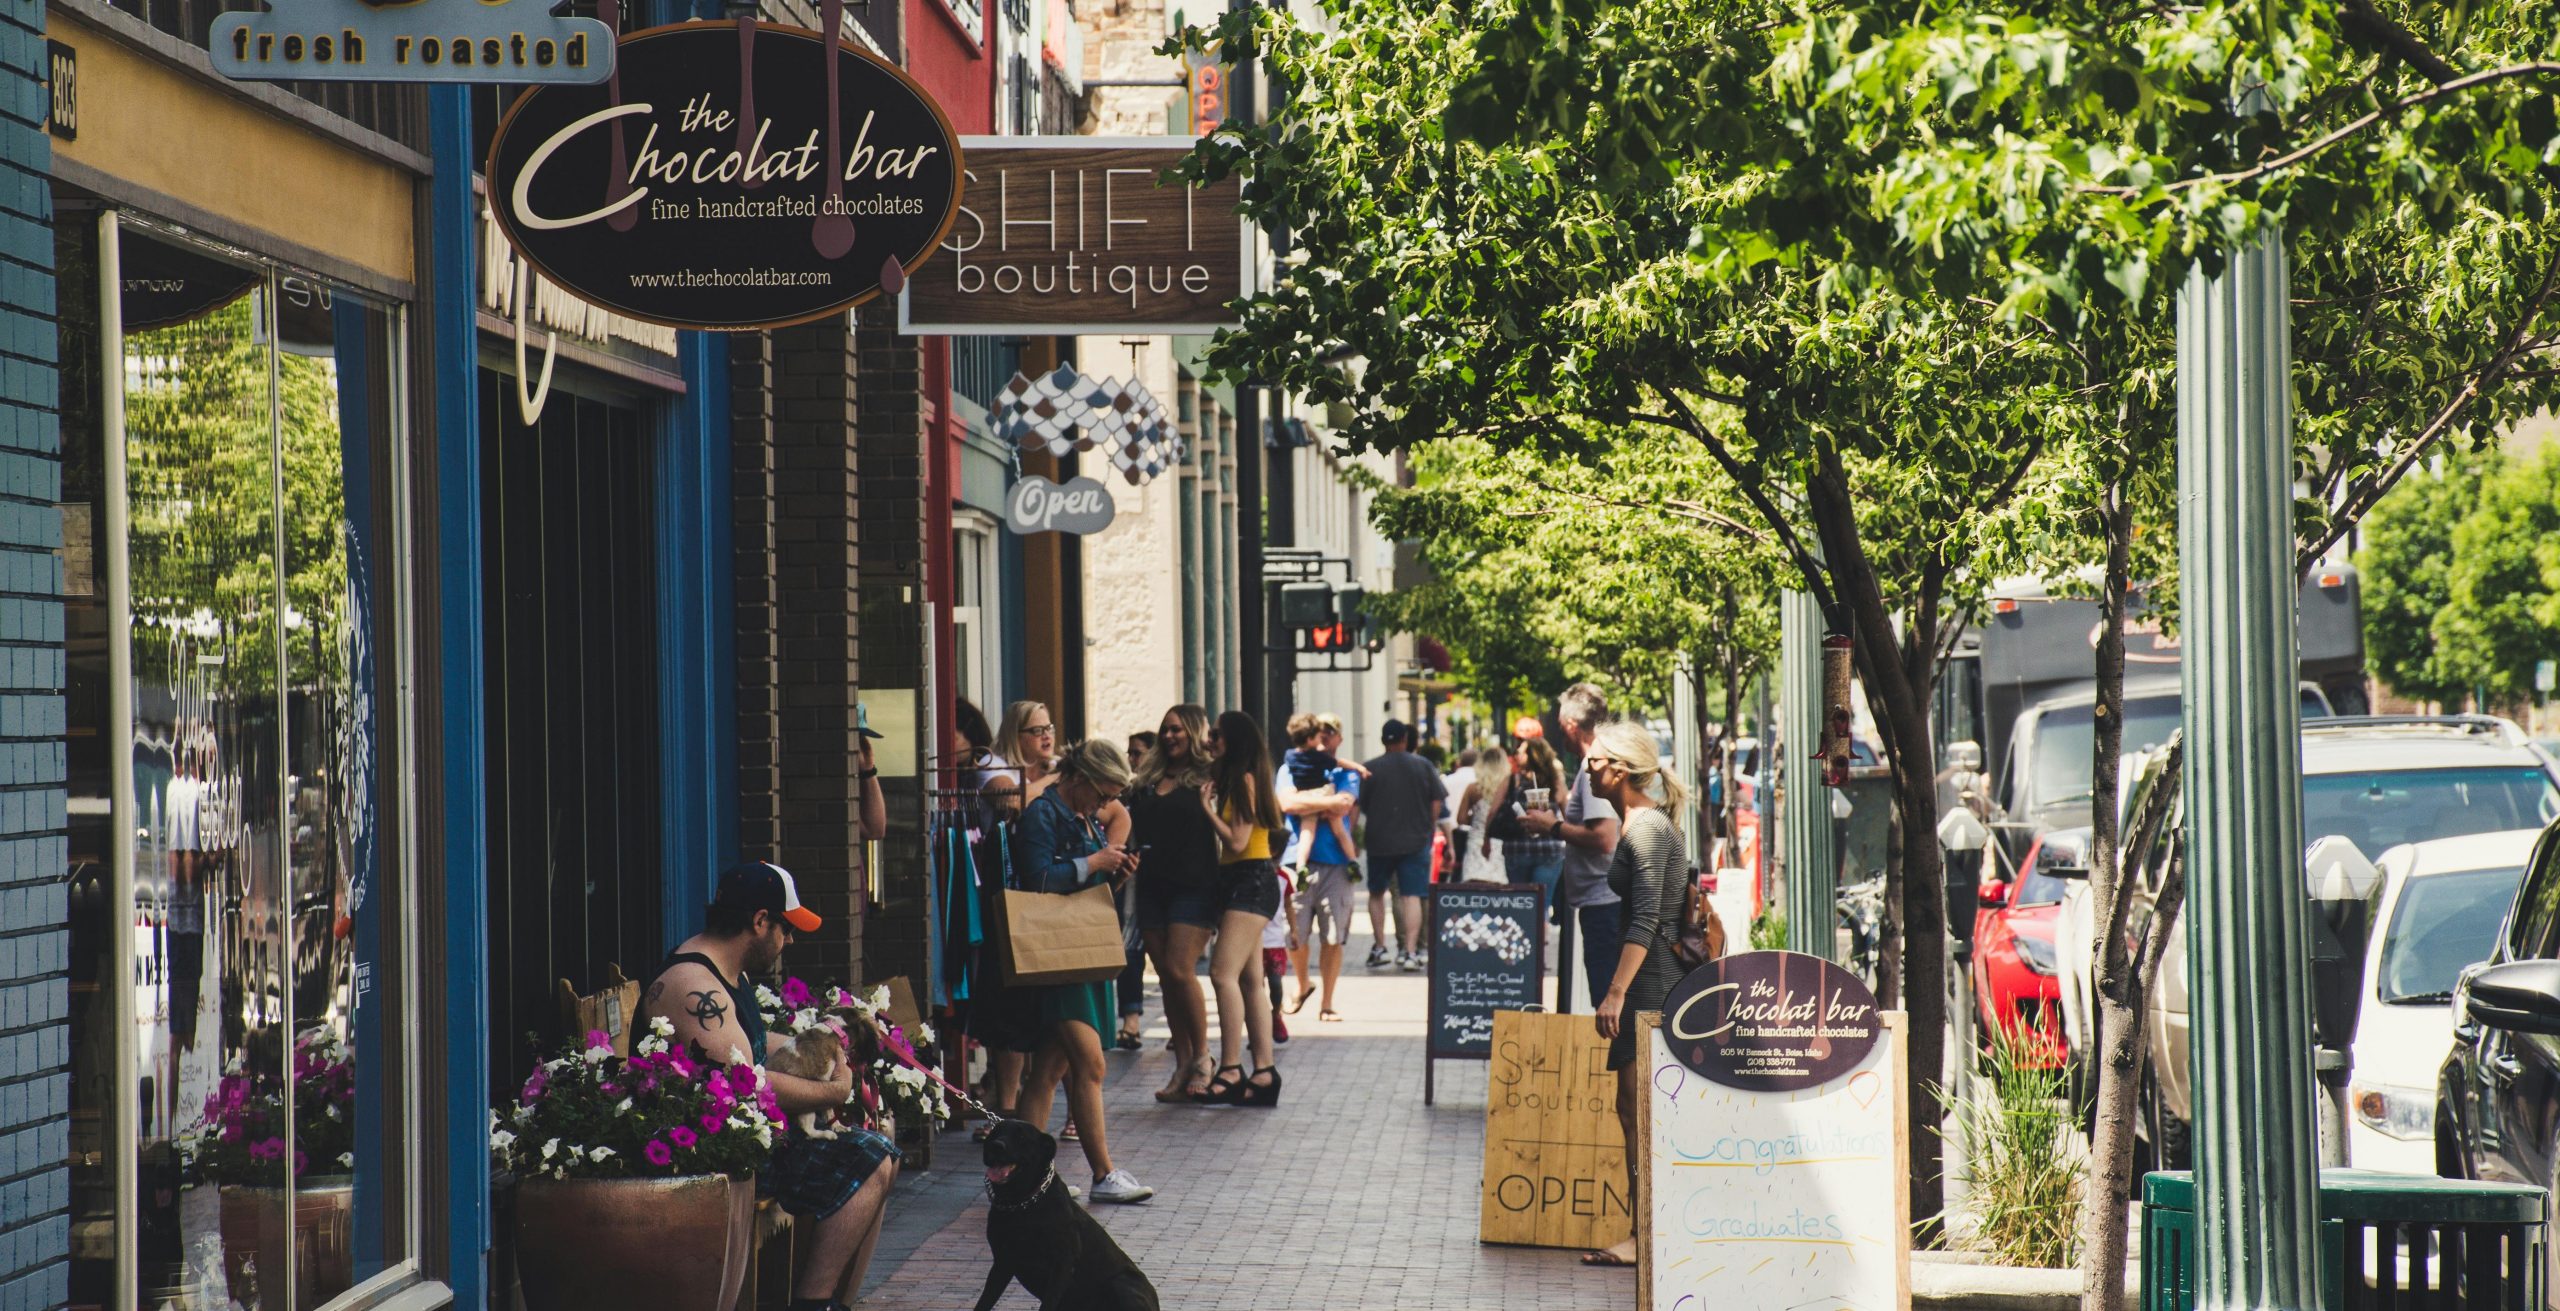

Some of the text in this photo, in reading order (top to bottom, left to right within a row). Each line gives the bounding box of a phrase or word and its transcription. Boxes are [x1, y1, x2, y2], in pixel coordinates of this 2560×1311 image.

[232, 25, 589, 68] fresh roasted
[53, 54, 76, 129] 803
[679, 92, 735, 132] the
[1198, 65, 1220, 137] OPE
[512, 103, 937, 230] Chocolat bar
[651, 193, 923, 220] fine handcrafted chocolates
[629, 268, 832, 289] www.thechocolatbar.com
[957, 235, 1210, 309] boutique
[1014, 479, 1104, 530] Open
[1750, 978, 1777, 998] the
[1672, 983, 1871, 1040] Chocolat bar
[1736, 1025, 1869, 1038] fine handcrafted chocolates
[1496, 1041, 1612, 1088] SHIF
[1506, 1078, 1618, 1120] boutiq
[1497, 1174, 1631, 1217] OPEN
[1683, 1186, 1843, 1239] Graduates
